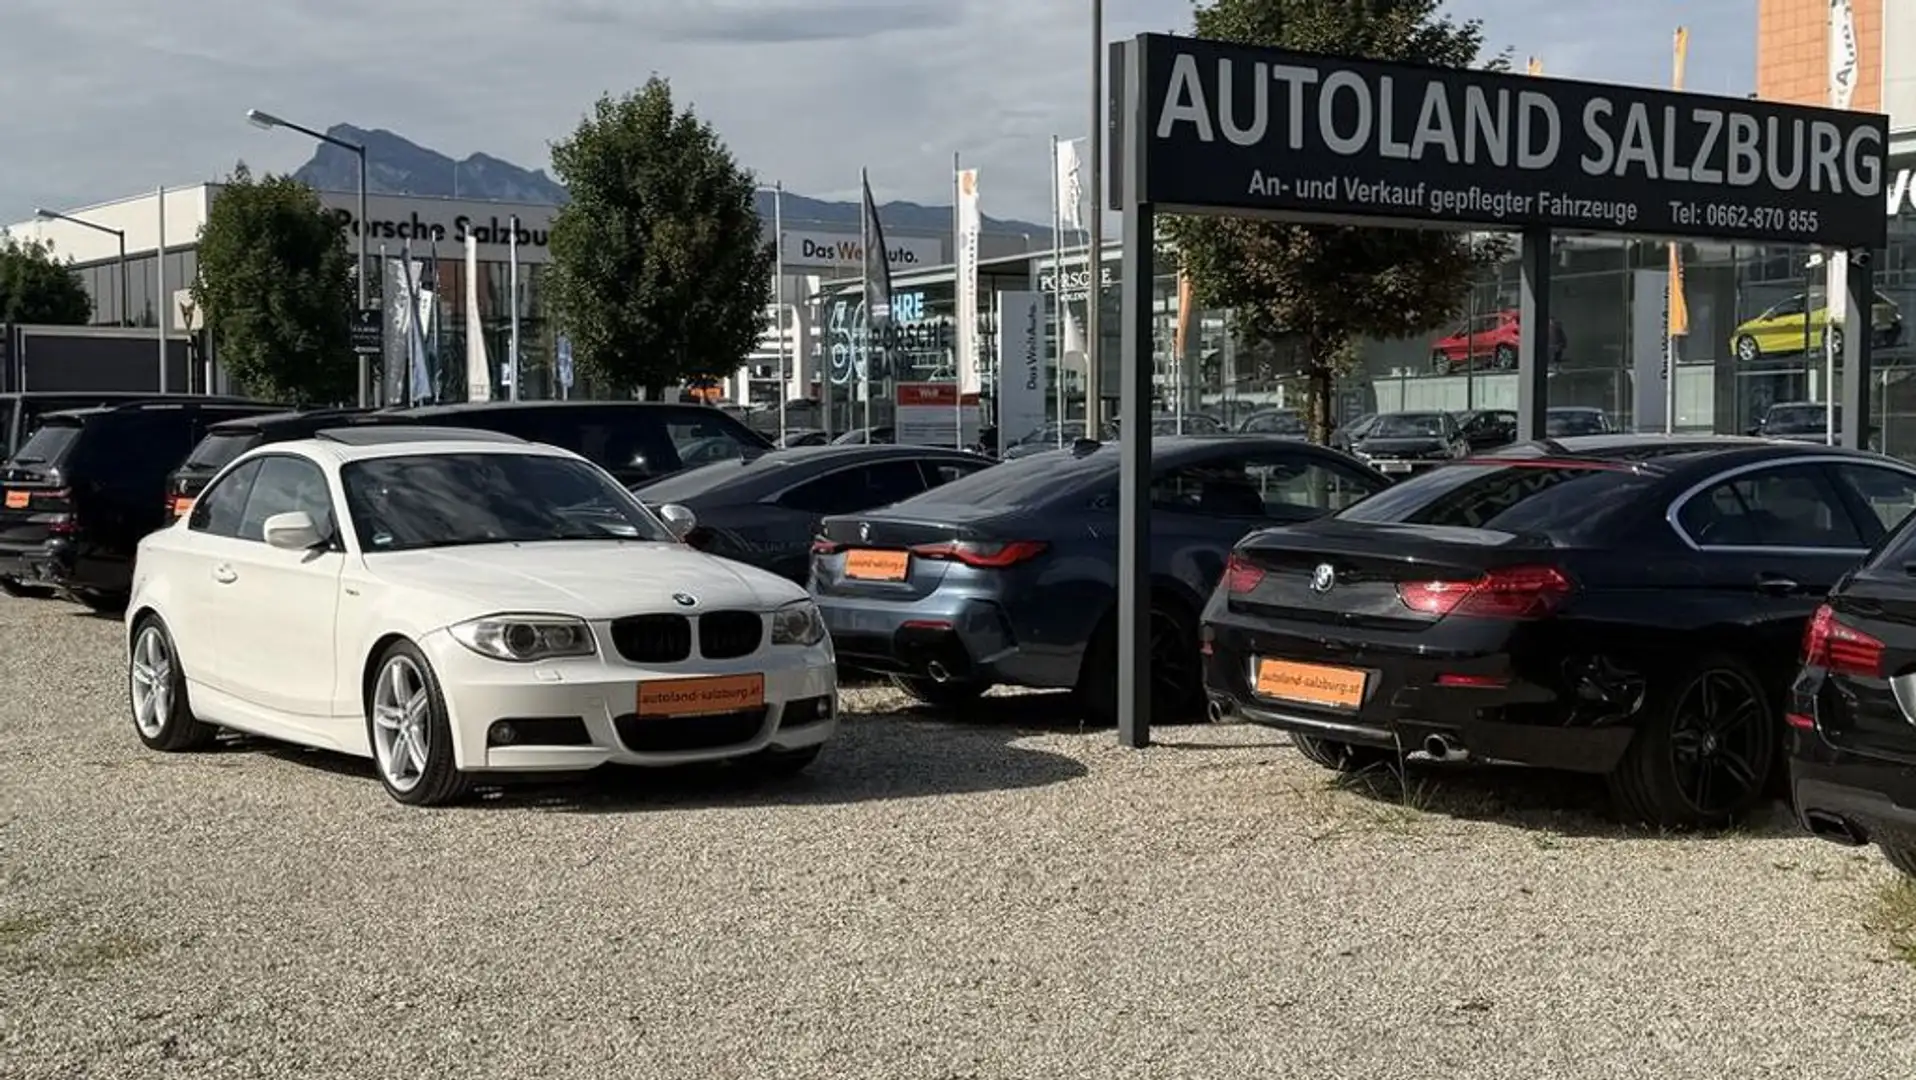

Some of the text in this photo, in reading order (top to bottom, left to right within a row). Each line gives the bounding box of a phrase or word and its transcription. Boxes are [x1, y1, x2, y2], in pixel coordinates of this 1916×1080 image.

[1156, 54, 1881, 197] AUTOLAND SALZBURG
[1249, 169, 1637, 226] An- und Verkauf gepflegter Fahrzeuge
[454, 214, 549, 247] Salzbu
[1669, 200, 1818, 232] Tel: 0662-870 855
[1039, 267, 1112, 292] PORSCE
[642, 683, 760, 705] autoland-salzburg.at
